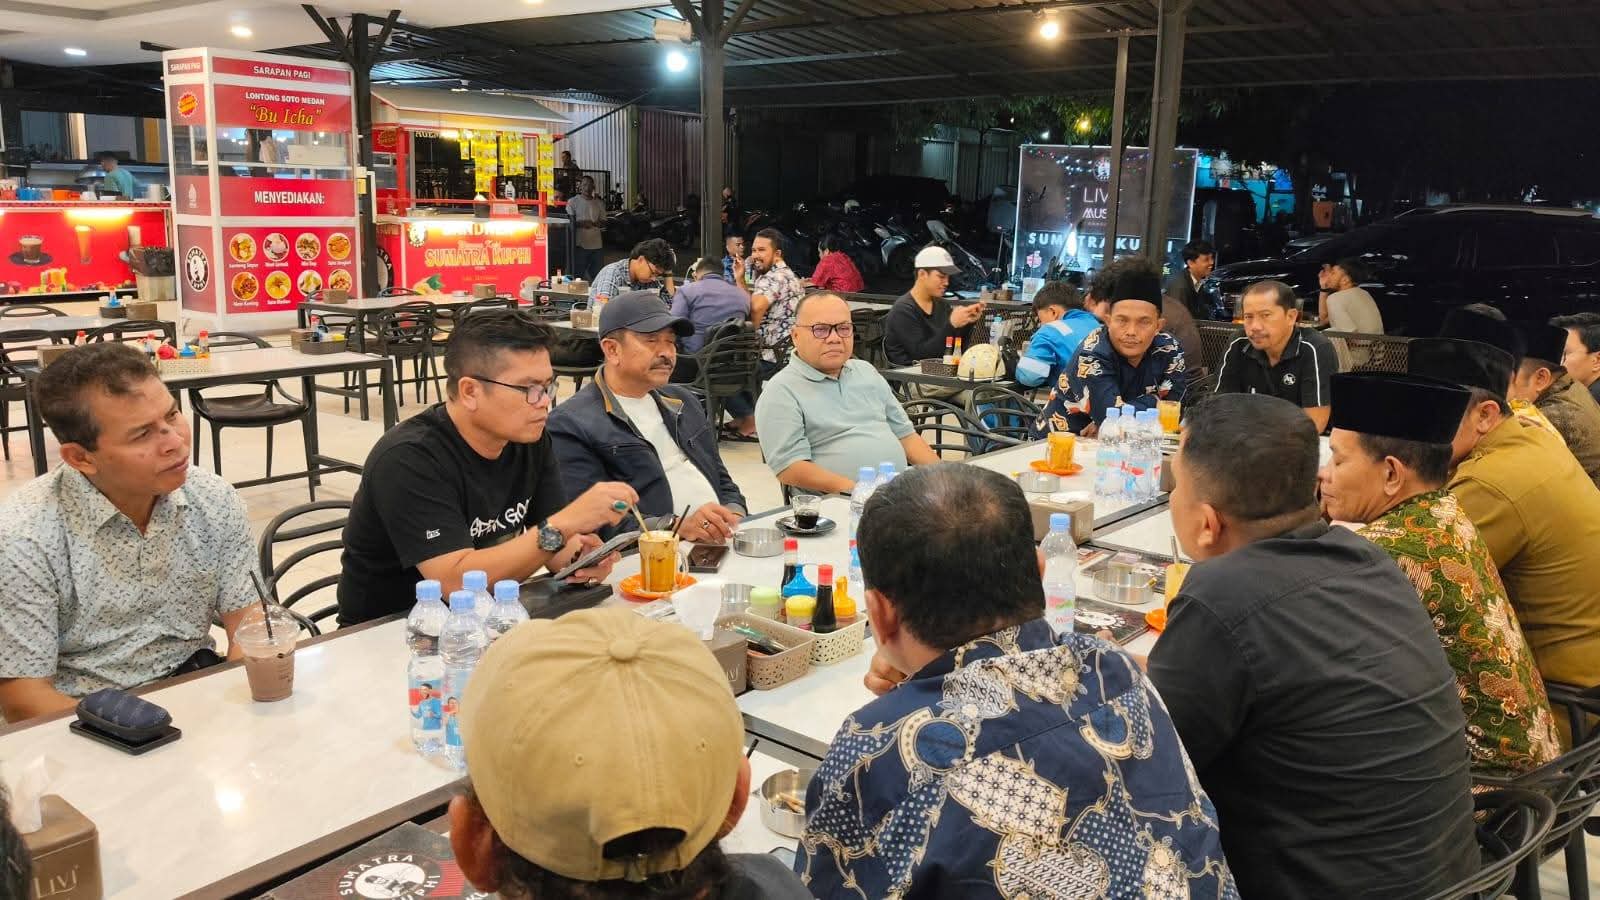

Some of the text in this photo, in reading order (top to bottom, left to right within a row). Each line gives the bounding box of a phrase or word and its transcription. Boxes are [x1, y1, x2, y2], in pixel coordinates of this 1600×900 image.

[253, 66, 311, 79] SARAPAN PAGI
[245, 92, 325, 105] LONTONG SOTO MEDAN
[254, 191, 325, 205] MENYEDIAKAN:
[425, 247, 532, 267] SUMATRA KUPHI
[338, 854, 414, 896] SUMATRA
